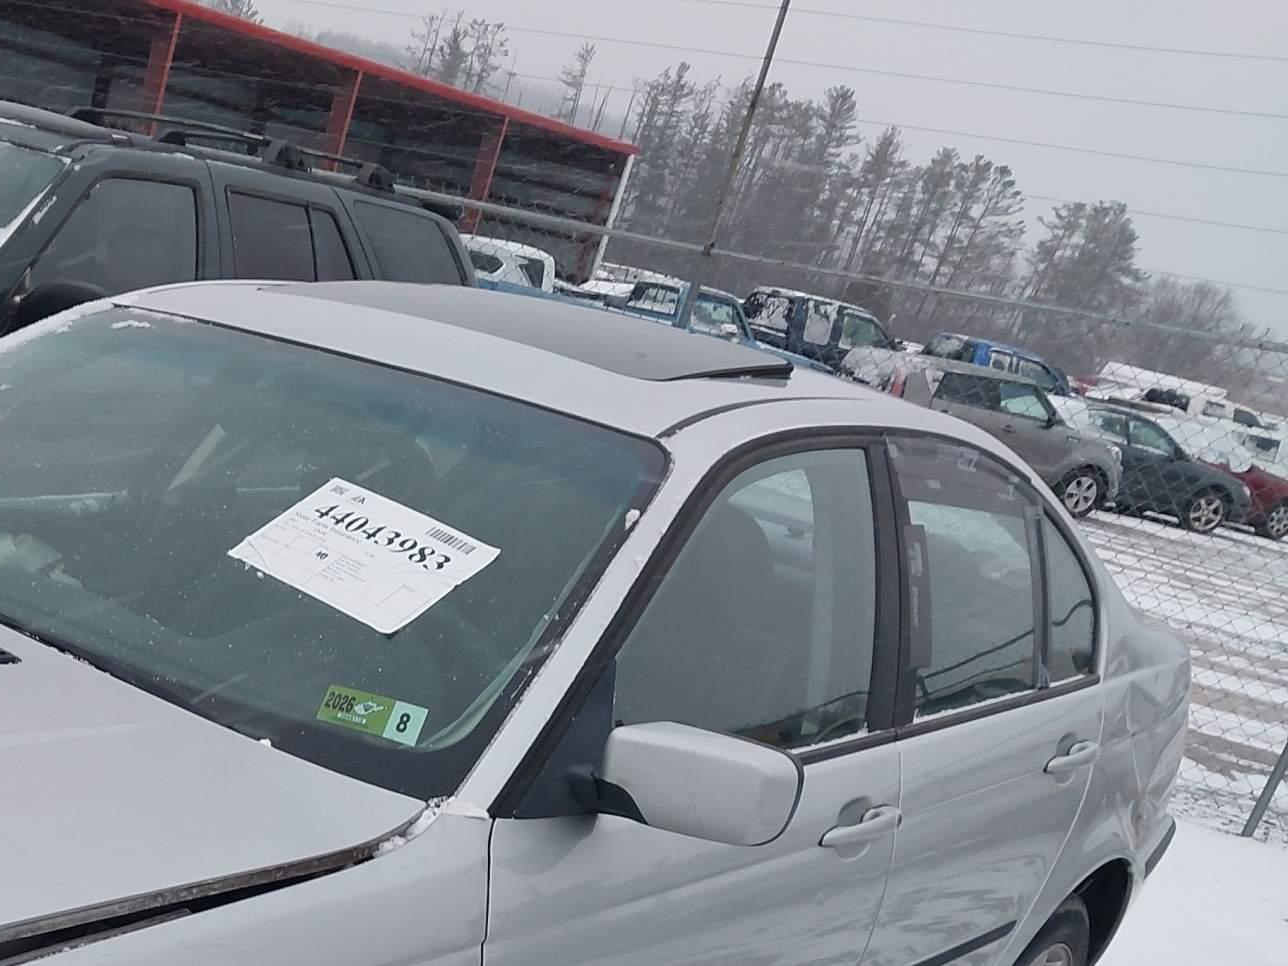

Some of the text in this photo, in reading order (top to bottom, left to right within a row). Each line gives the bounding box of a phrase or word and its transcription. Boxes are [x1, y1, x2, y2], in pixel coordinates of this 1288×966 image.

[314, 504, 452, 571] 44043983
[324, 691, 357, 713] 2026
[395, 712, 412, 733] 8
